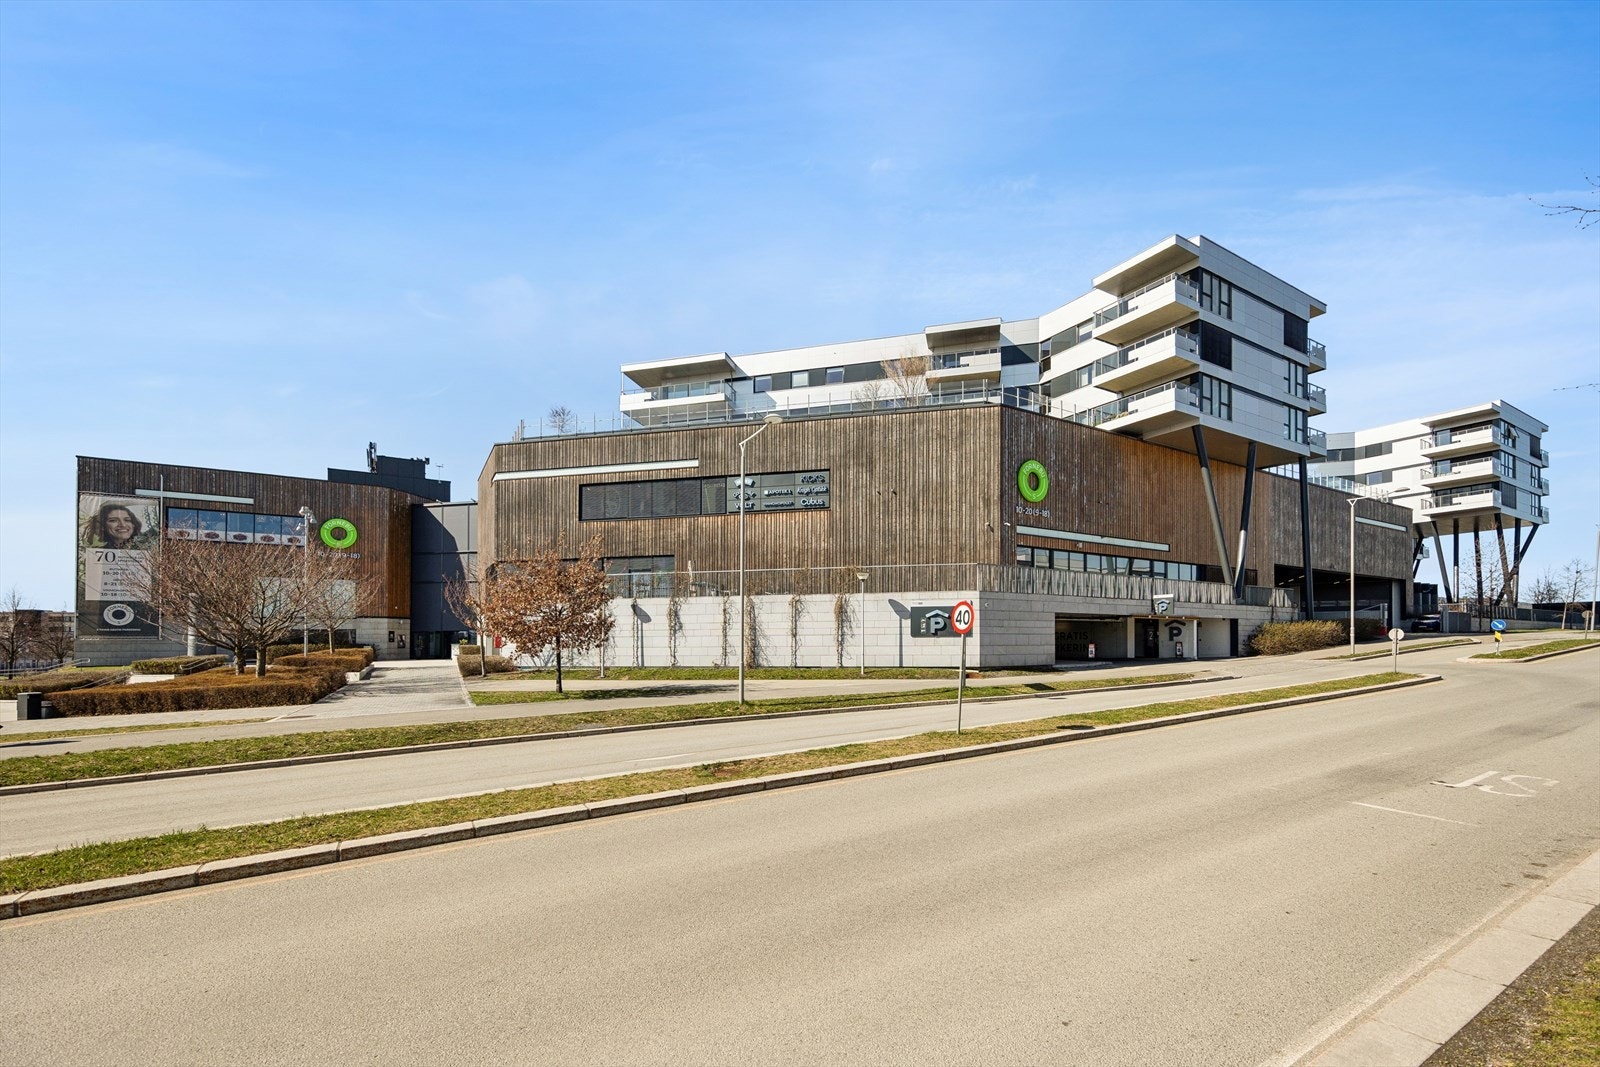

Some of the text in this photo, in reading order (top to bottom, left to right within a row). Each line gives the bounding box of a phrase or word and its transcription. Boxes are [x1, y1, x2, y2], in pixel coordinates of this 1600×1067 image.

[1023, 463, 1046, 478] FORNEBU
[734, 501, 753, 509] VLT
[801, 498, 823, 506] Cubus
[324, 520, 353, 531] FORNEBU
[95, 550, 116, 562] 70
[1159, 604, 1169, 614] P
[956, 610, 970, 626] 40
[930, 617, 945, 634] P
[1169, 626, 1182, 641] P
